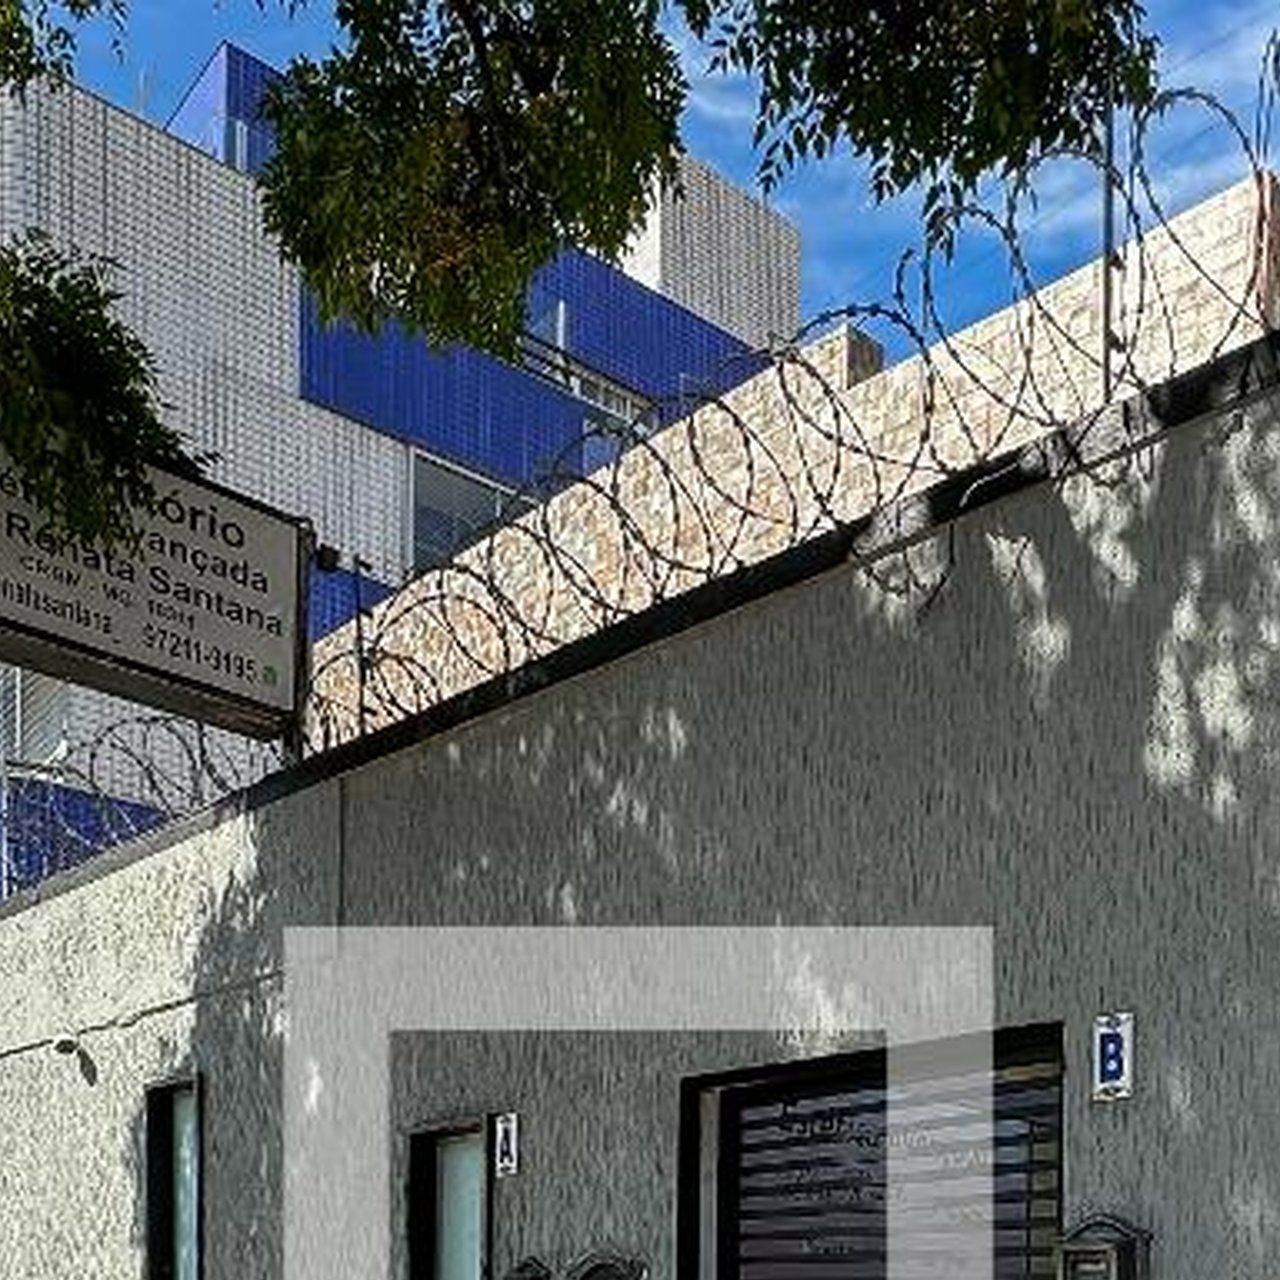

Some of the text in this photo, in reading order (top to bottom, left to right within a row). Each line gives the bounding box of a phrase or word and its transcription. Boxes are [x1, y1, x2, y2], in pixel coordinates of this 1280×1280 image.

[148, 565, 282, 636] Santana
[1100, 1034, 1123, 1083] B
[499, 1126, 513, 1155] A
